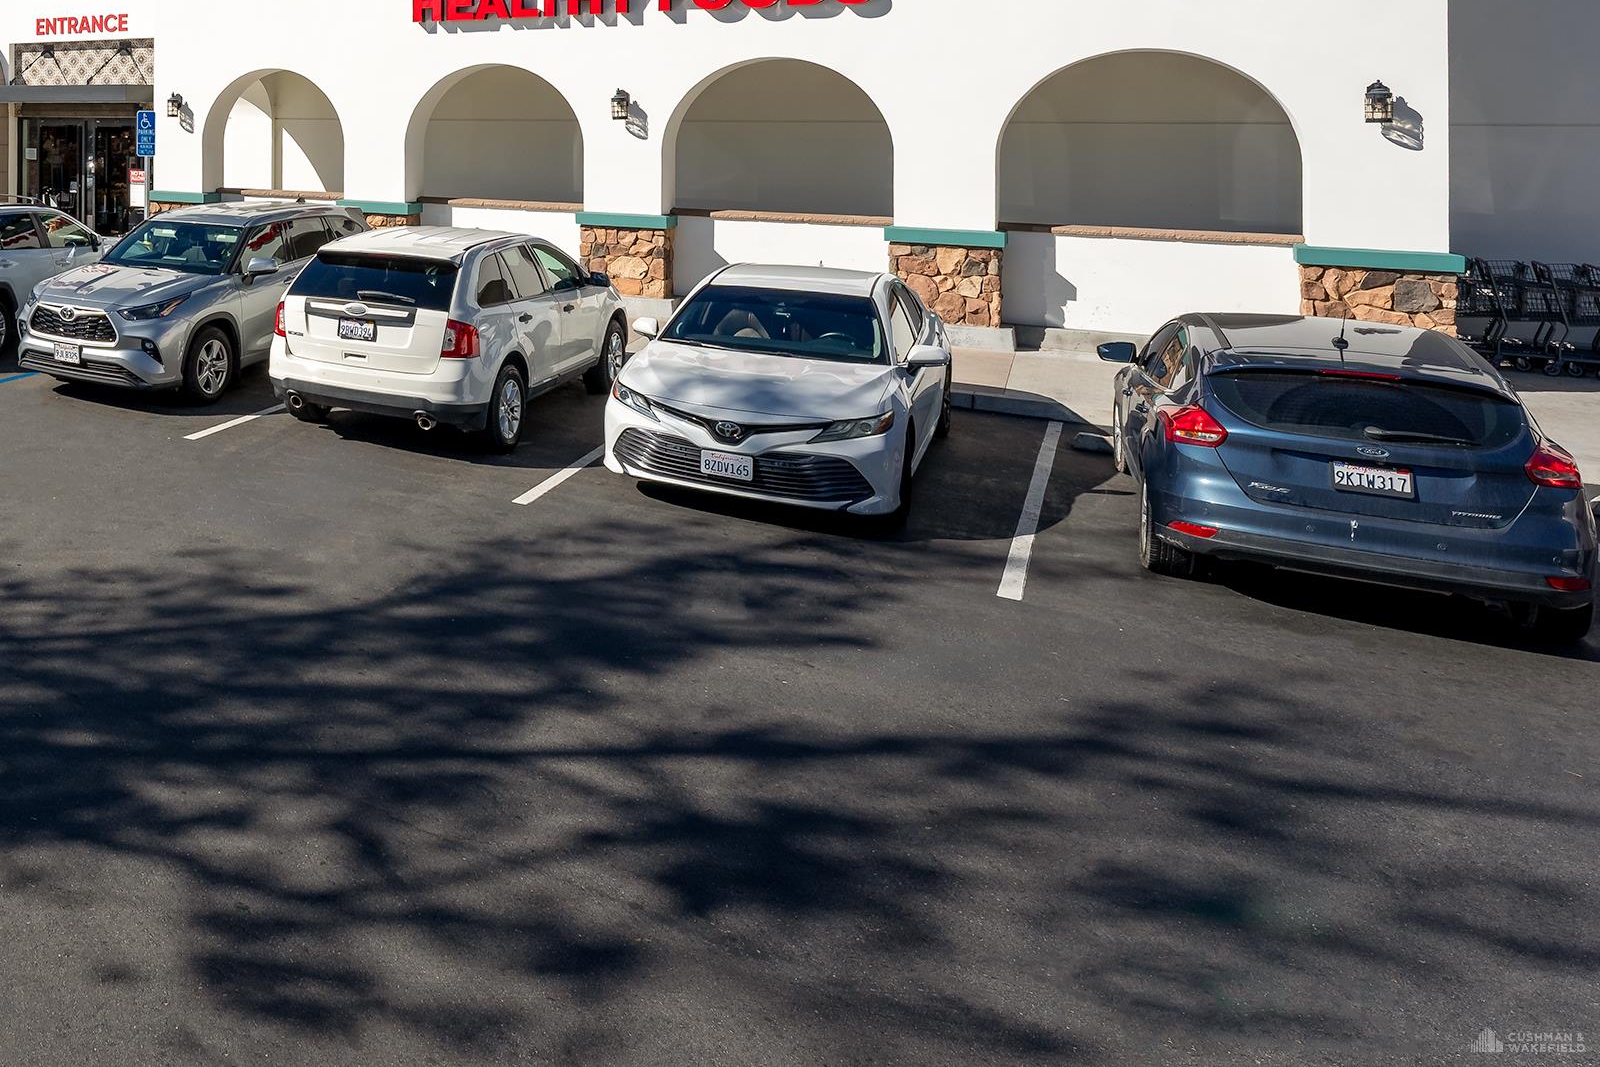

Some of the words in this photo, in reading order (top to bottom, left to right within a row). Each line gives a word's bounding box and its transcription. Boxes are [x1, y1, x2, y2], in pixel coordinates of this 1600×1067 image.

[35, 13, 129, 36] ENTRANCE
[138, 128, 155, 136] PARKING
[704, 458, 750, 477] 8ZDV165
